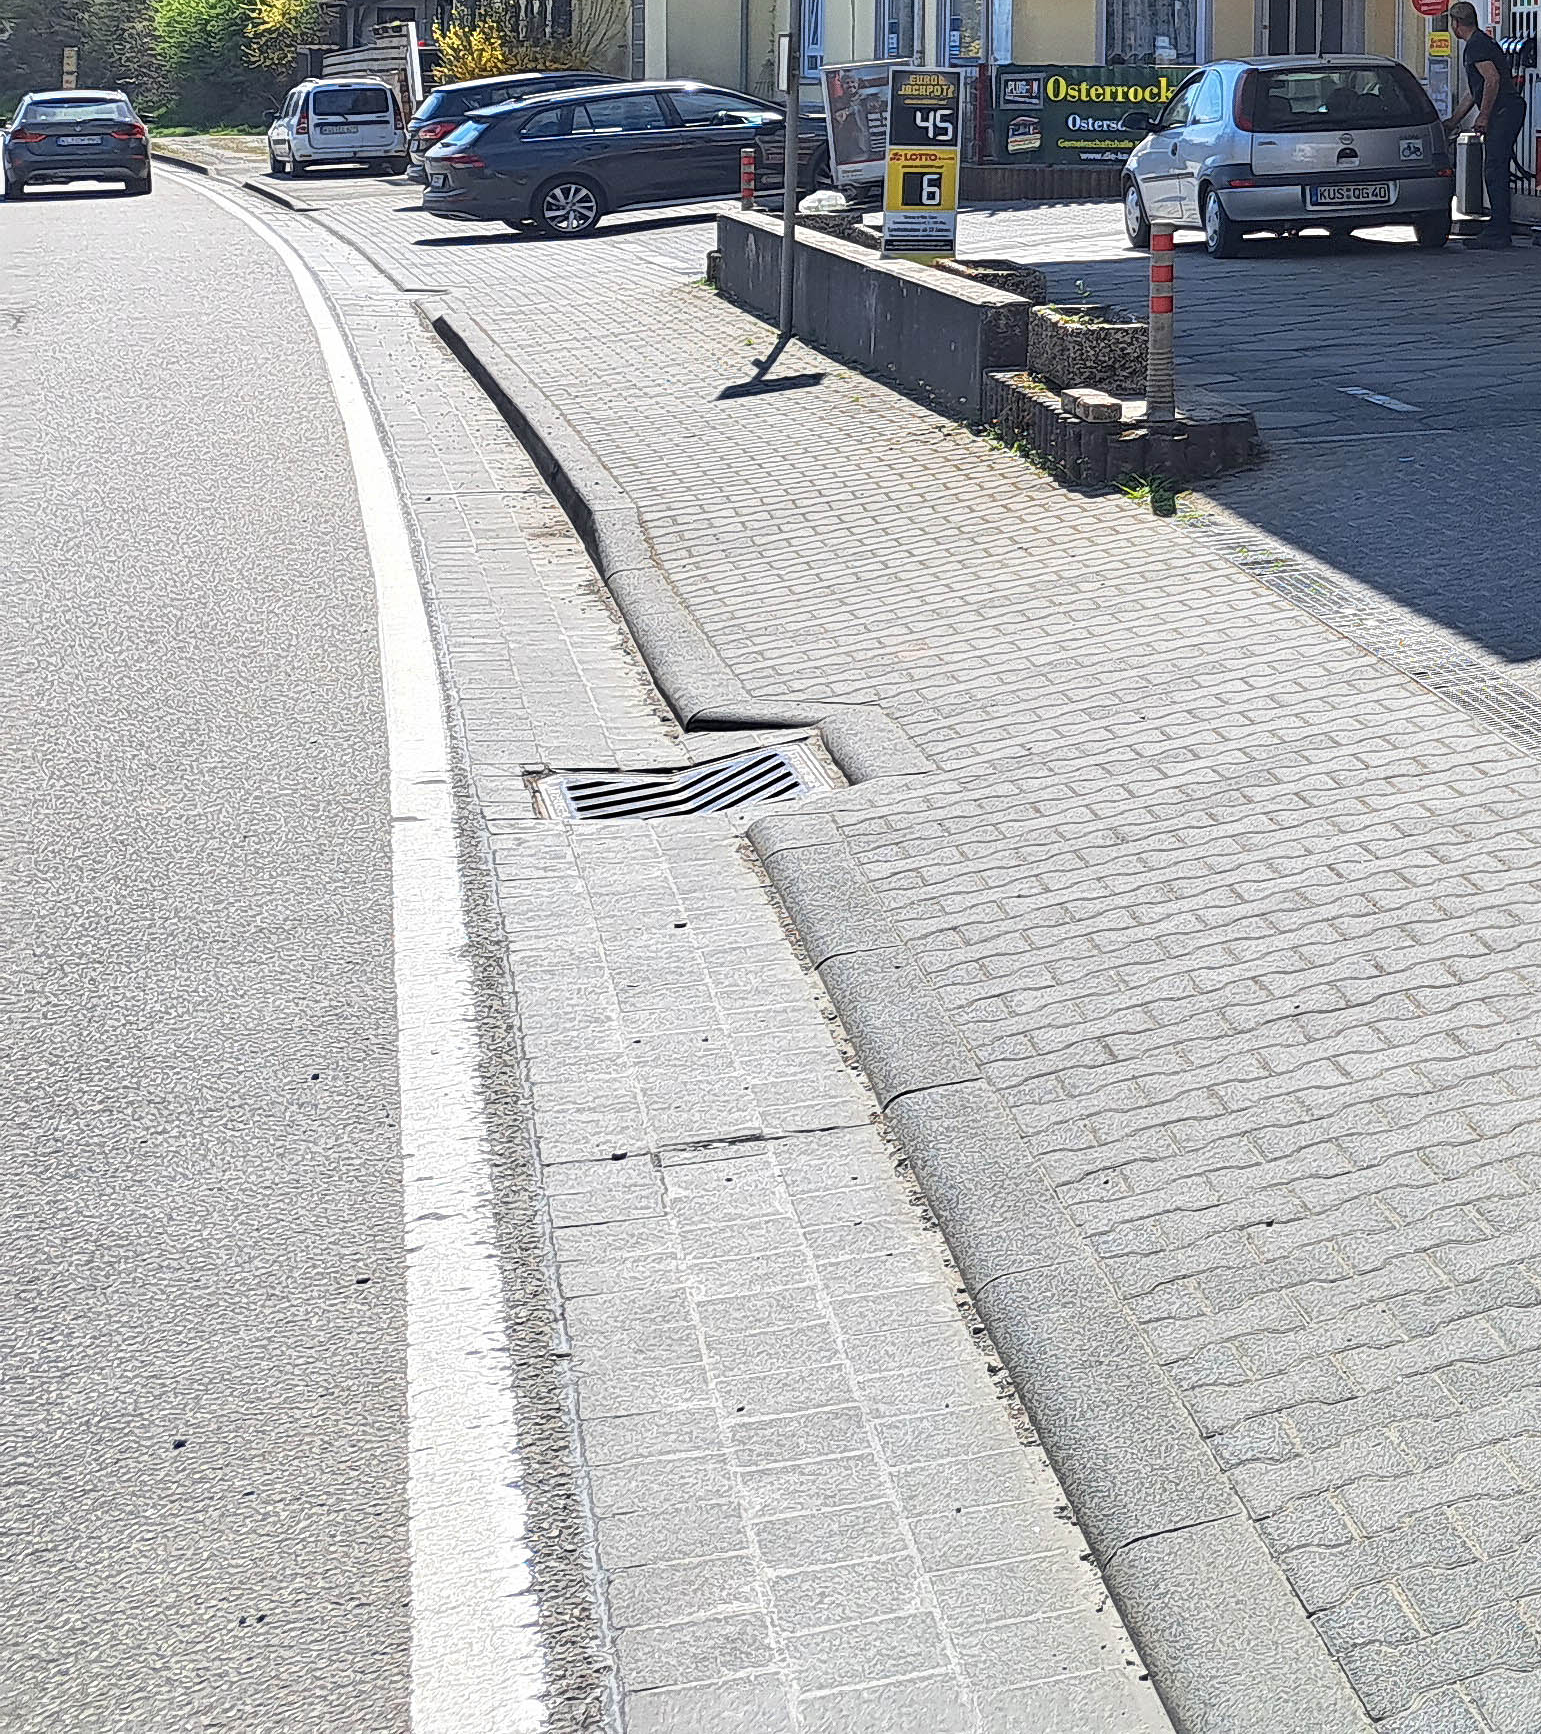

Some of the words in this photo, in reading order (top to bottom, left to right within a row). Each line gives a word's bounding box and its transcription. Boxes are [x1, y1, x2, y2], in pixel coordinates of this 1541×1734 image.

[909, 74, 939, 85] EURO
[914, 109, 954, 141] 45
[903, 152, 938, 162] LOTTO
[920, 173, 940, 205] 6
[1319, 187, 1345, 201] KUS
